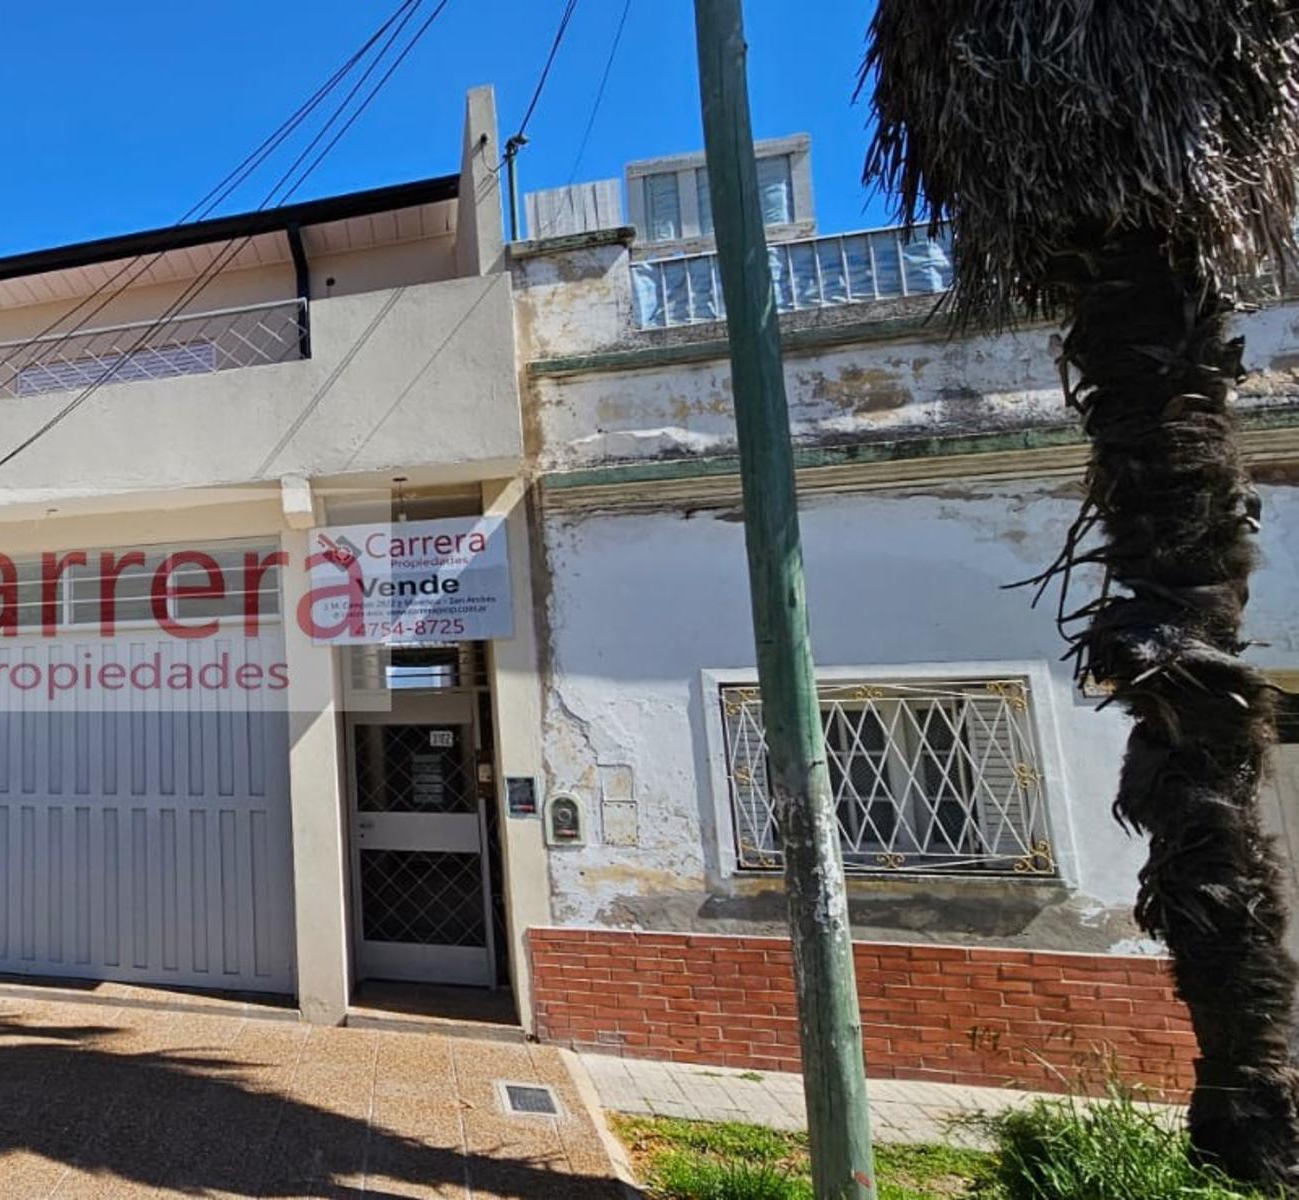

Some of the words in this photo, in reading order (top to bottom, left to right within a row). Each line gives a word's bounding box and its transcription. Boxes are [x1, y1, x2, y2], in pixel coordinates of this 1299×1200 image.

[365, 532, 487, 559] Carrera
[391, 556, 469, 569] Propiedades
[356, 575, 460, 598] Vende
[355, 618, 465, 637] 4754-8725
